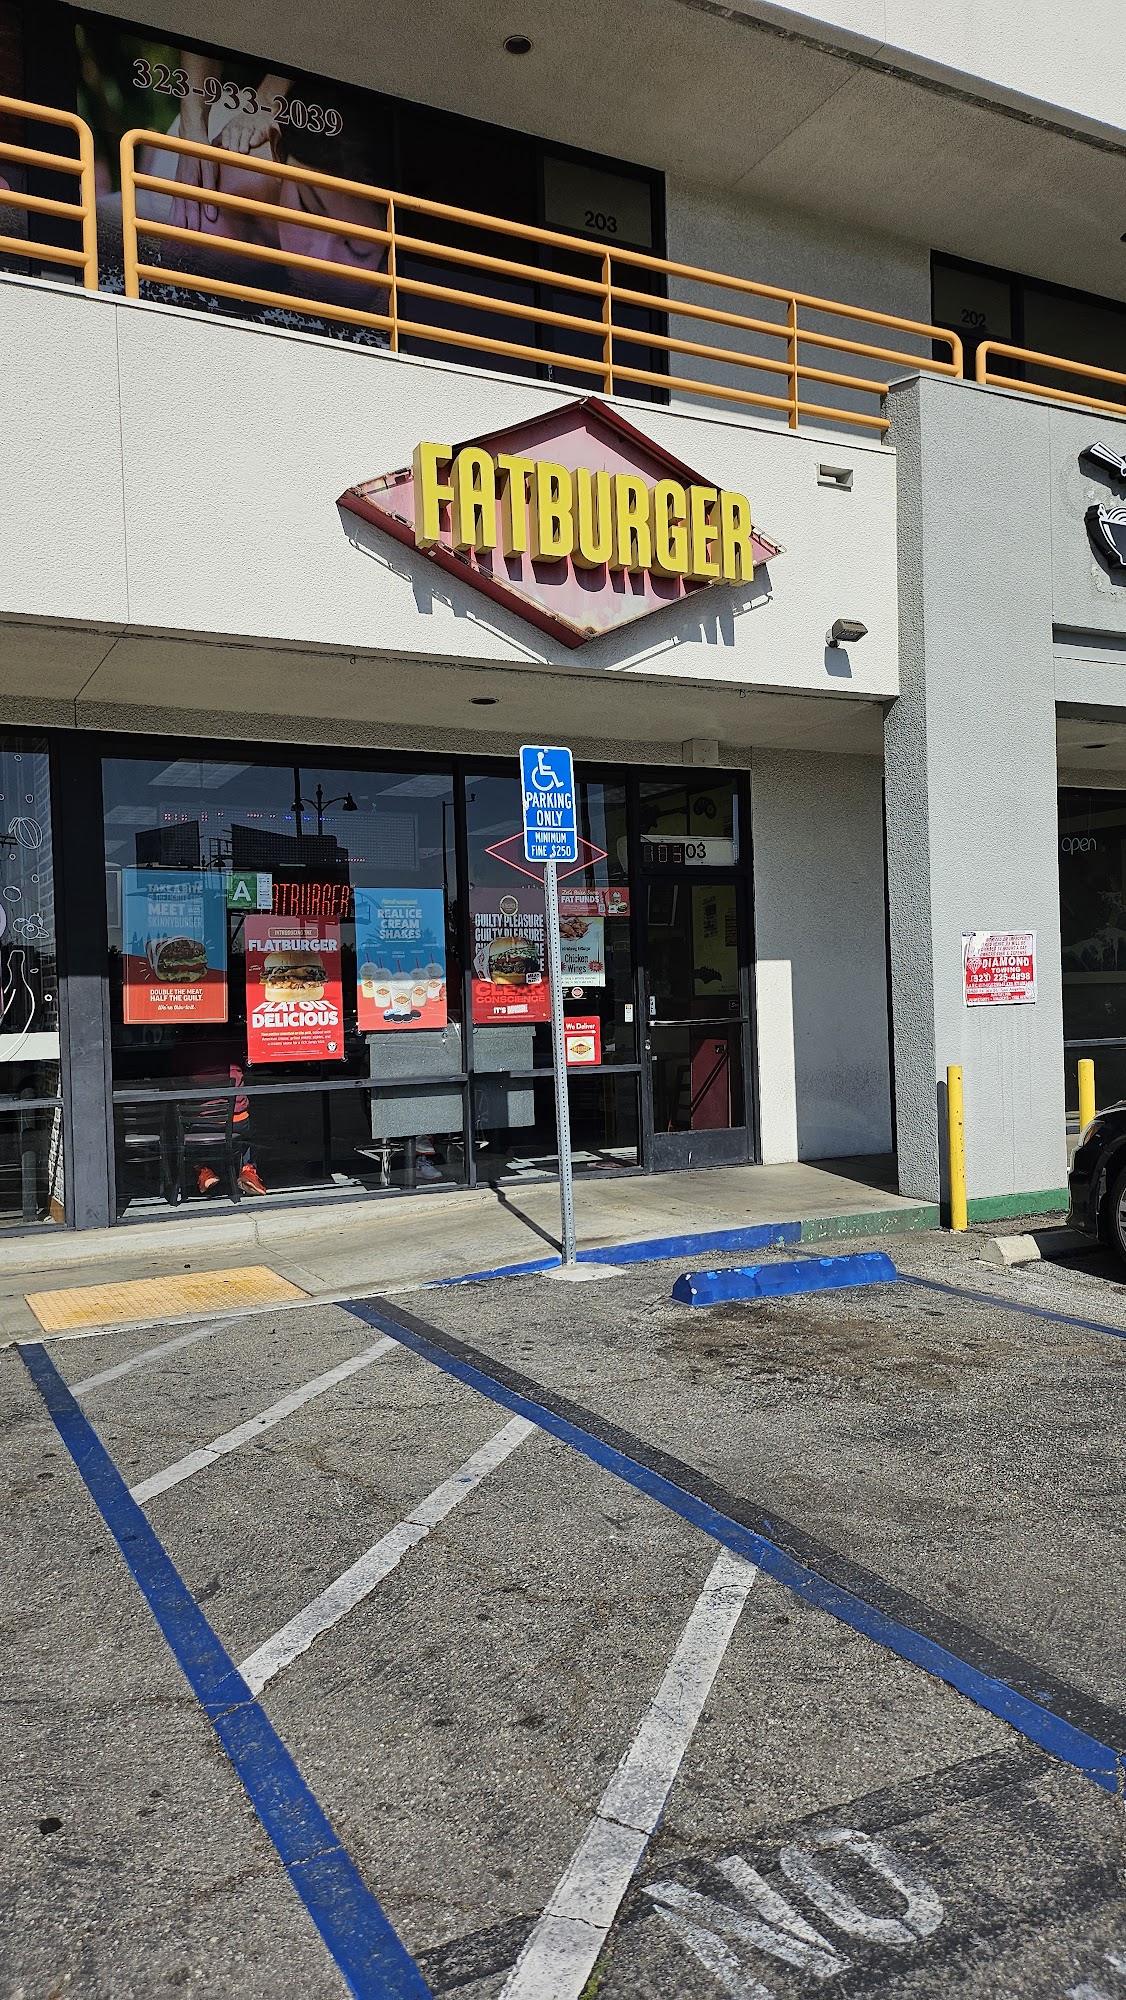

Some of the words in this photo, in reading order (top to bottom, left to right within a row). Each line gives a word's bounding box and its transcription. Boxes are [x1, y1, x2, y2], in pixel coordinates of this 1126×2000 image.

[133, 59, 343, 136] 323-933-2039
[584, 210, 617, 233] 203
[961, 309, 986, 328] 202
[412, 441, 755, 587] FATBURGER
[526, 792, 572, 809] PARKING
[536, 810, 563, 826] ONLY
[535, 832, 567, 843] MINIMUM
[531, 845, 547, 856] FINE
[551, 844, 571, 857] $250
[1061, 837, 1097, 855] open
[232, 880, 251, 901] A
[260, 883, 350, 917] ATBURGER
[560, 896, 575, 904] FAT
[575, 895, 600, 904] FUNDS
[148, 903, 186, 915] MEET
[377, 908, 405, 919] REAL
[405, 908, 422, 919] ICE
[147, 916, 203, 928] SKINNYBURGER
[380, 919, 420, 929] CREAM
[474, 913, 503, 928] GUILTY
[503, 913, 544, 928] PLEASURE
[379, 929, 422, 939] SHAKES
[248, 939, 338, 952] FLATBURGER
[564, 953, 589, 963] Chicken
[982, 956, 1030, 969] DIAMOND
[567, 964, 587, 974] Wings
[990, 966, 1021, 974] TOWING
[252, 1001, 295, 1012] FLAT
[299, 1000, 339, 1011] OUT
[475, 995, 546, 1004] CONSCIENCE
[252, 1011, 339, 1028] DELICIOUS
[576, 1022, 596, 1030] Deliver
[642, 1826, 943, 2000] NO
